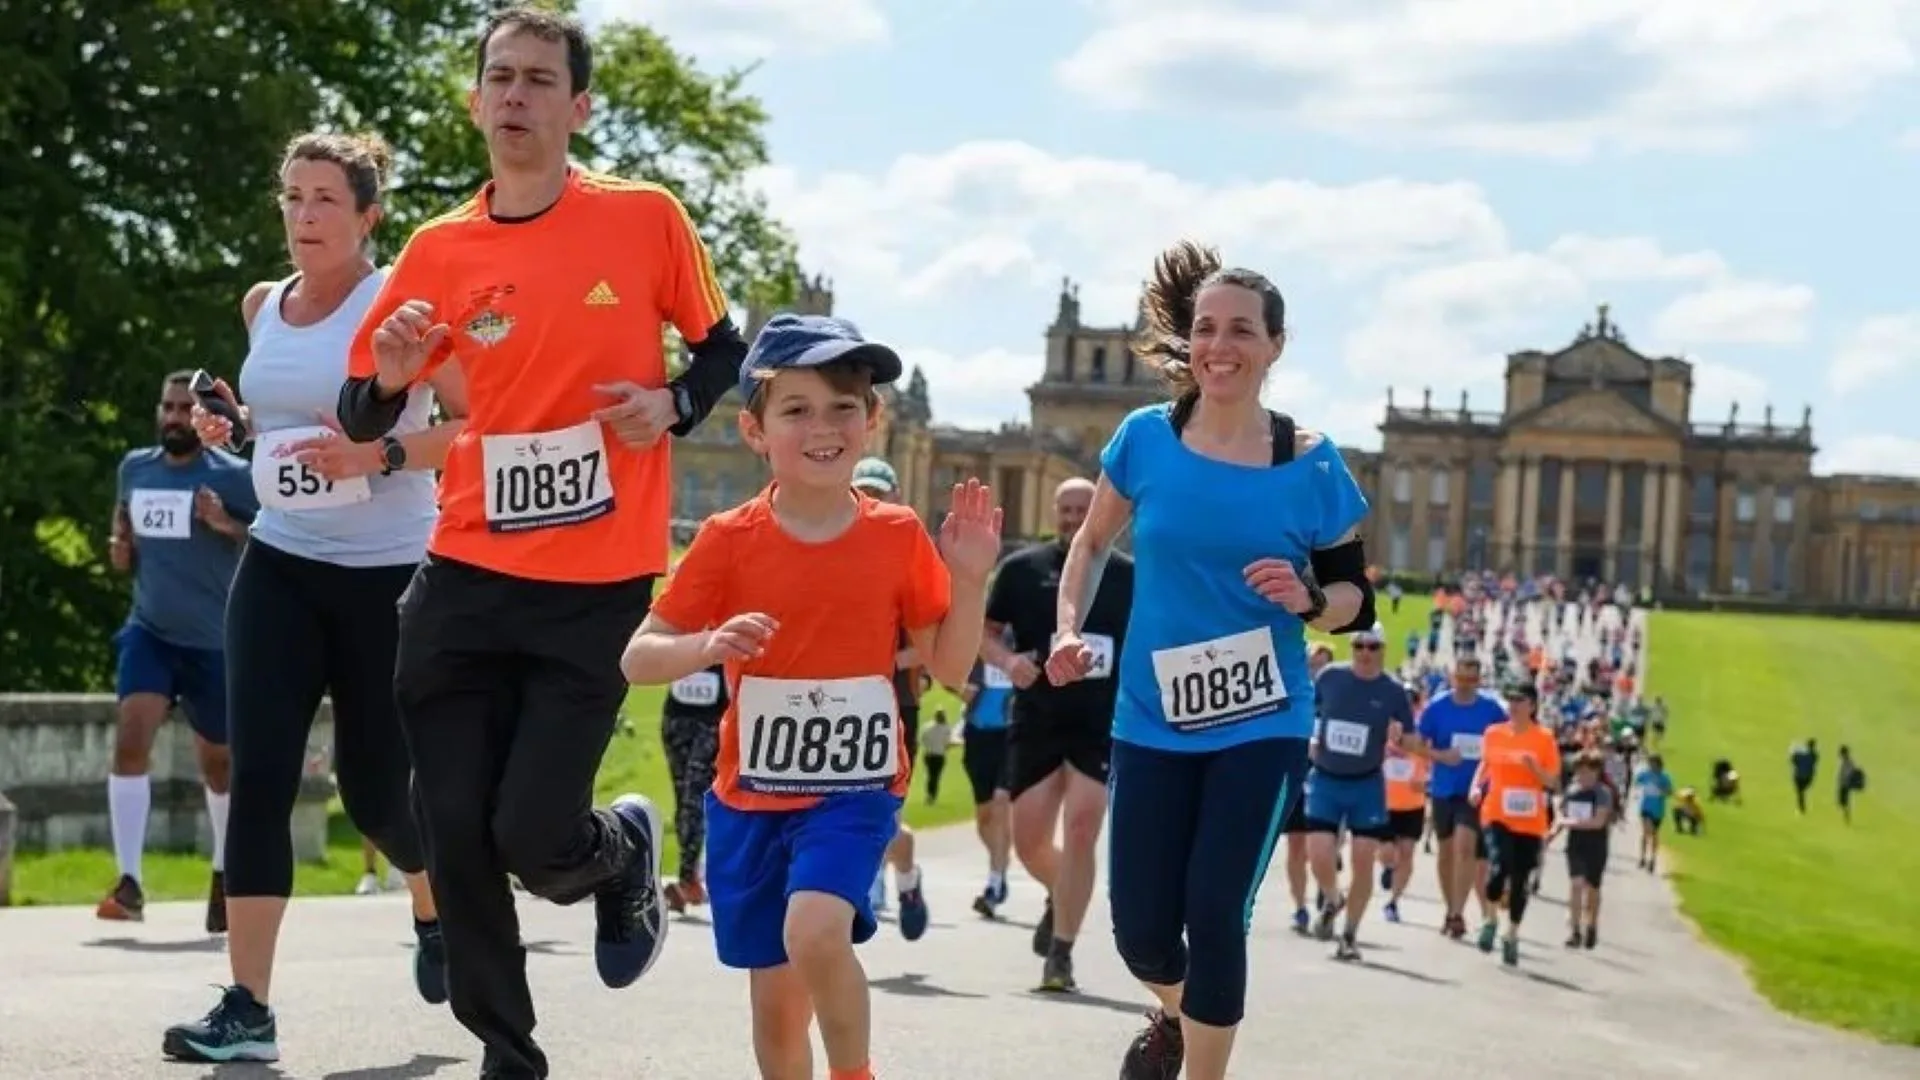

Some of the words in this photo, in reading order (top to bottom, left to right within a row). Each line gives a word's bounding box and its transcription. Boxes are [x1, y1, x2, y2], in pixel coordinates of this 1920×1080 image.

[496, 450, 600, 514] 10837
[143, 508, 174, 529] 621
[1172, 654, 1274, 717] 10834
[748, 712, 891, 773] 10836
